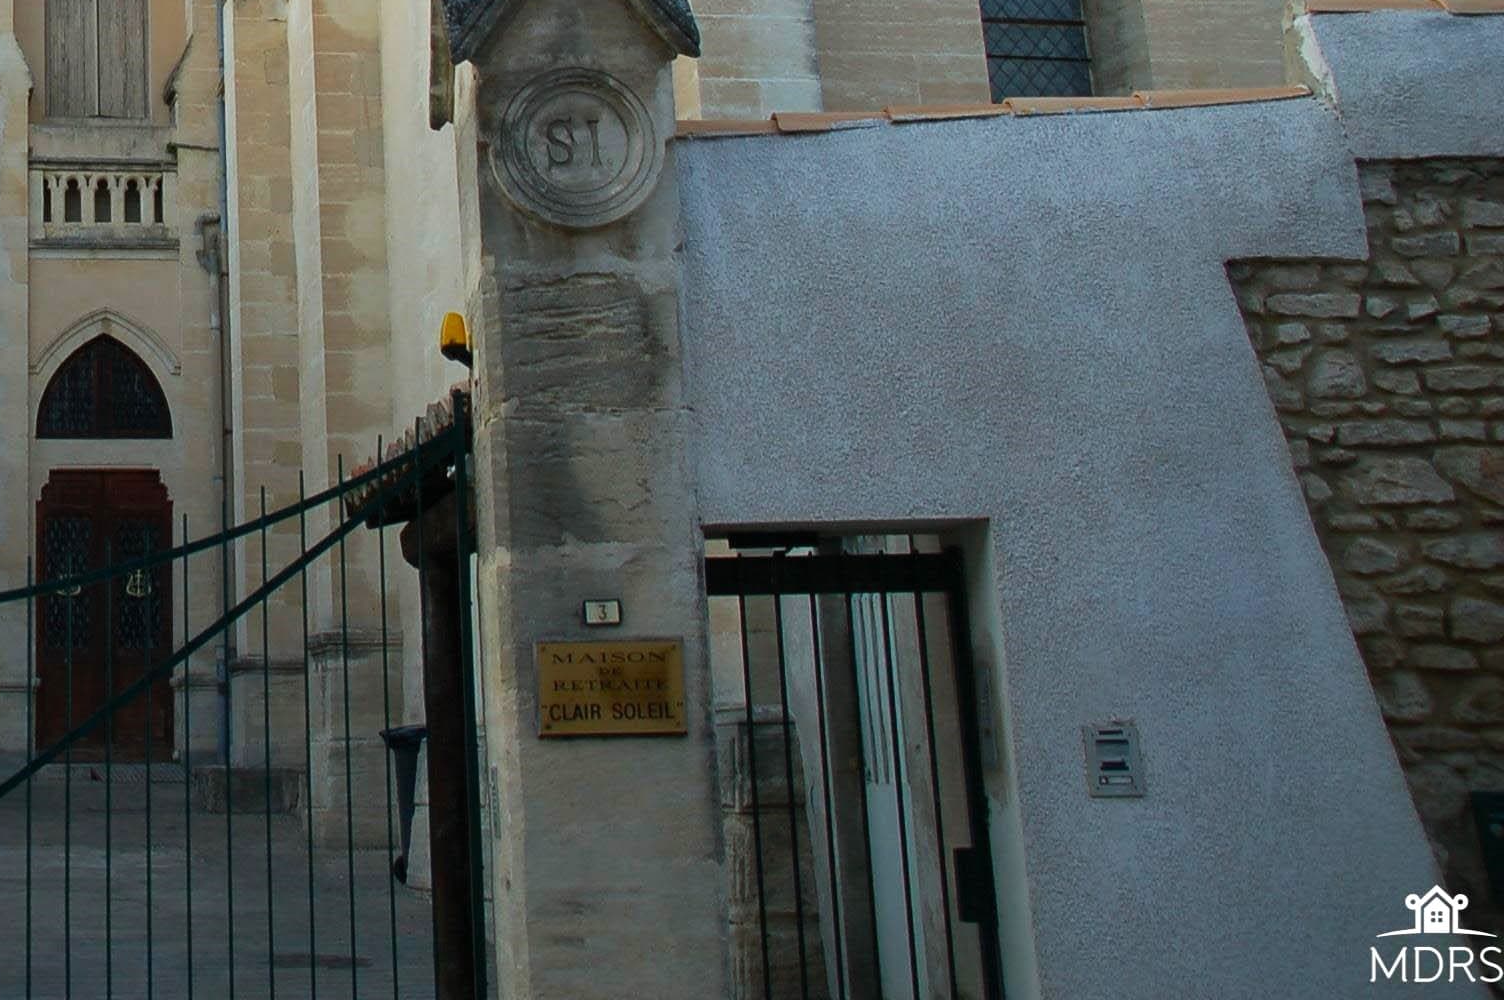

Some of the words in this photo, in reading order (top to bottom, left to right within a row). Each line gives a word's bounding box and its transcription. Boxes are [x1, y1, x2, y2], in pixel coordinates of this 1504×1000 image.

[598, 604, 607, 620] 3
[552, 652, 667, 664] MAISON
[598, 667, 623, 676] DE
[553, 679, 670, 692] RETRAITE
